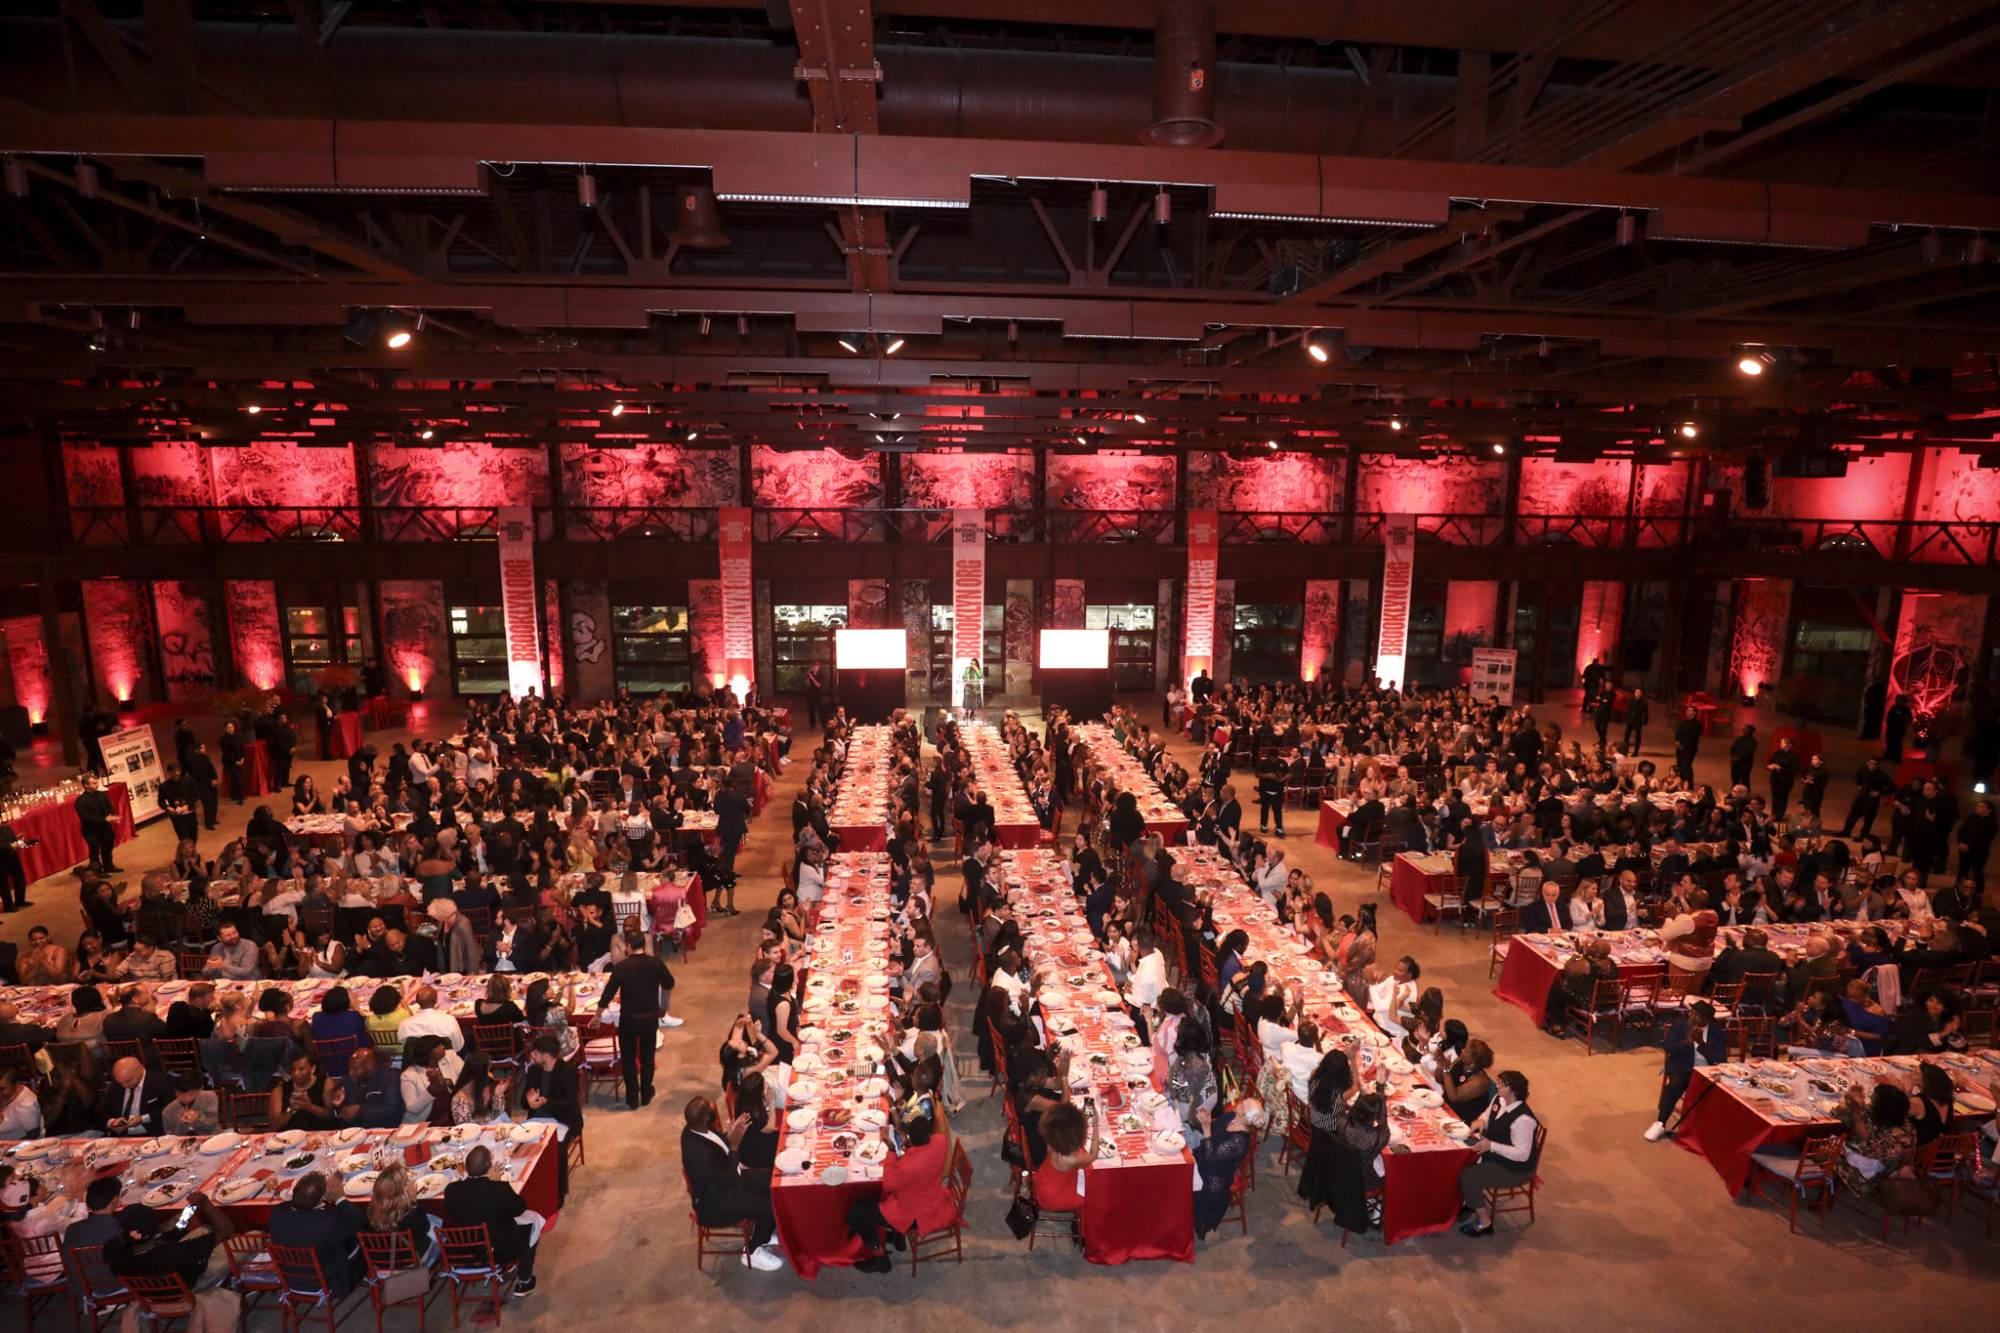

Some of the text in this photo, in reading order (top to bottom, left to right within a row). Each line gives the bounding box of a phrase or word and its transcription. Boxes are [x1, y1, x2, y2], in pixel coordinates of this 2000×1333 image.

[956, 560, 982, 586] ORG
[503, 559, 537, 662] BROOKLYN ORG
[723, 558, 753, 659] BROOKLYN ORG
[956, 589, 982, 659] BROOKLYN
[1186, 560, 1215, 656] BROOKLYN ORG
[1380, 561, 1411, 656] BROOKLYN ORG
[108, 744, 141, 759] Benefit Auction
[1837, 1078, 1848, 1088] 58
[85, 1153, 96, 1166] 20
[374, 1149, 383, 1160] 21
